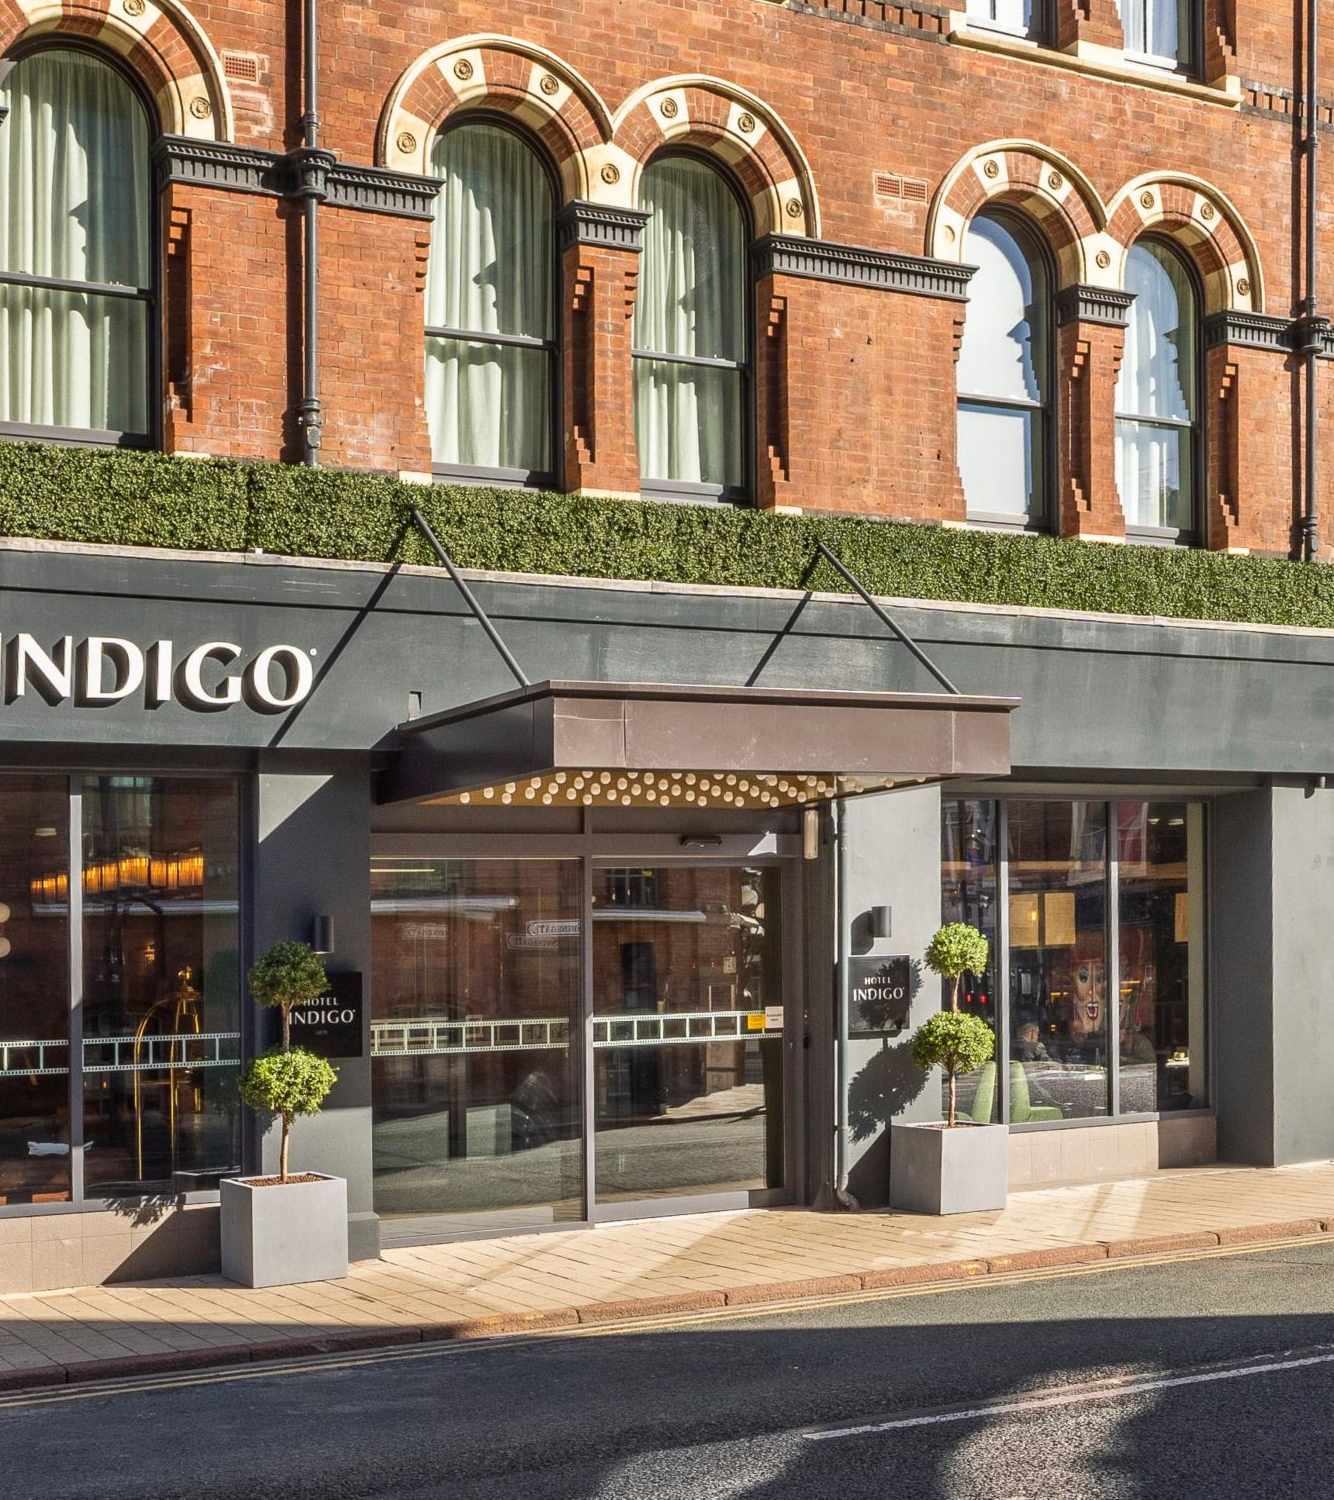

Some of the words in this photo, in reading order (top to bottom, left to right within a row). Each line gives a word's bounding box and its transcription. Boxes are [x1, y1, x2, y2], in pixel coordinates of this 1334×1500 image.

[864, 976, 892, 986] HOTEL
[853, 987, 905, 1002] INDIGO
[303, 997, 340, 1007] HOTEL
[288, 1009, 355, 1025] INDIGO
